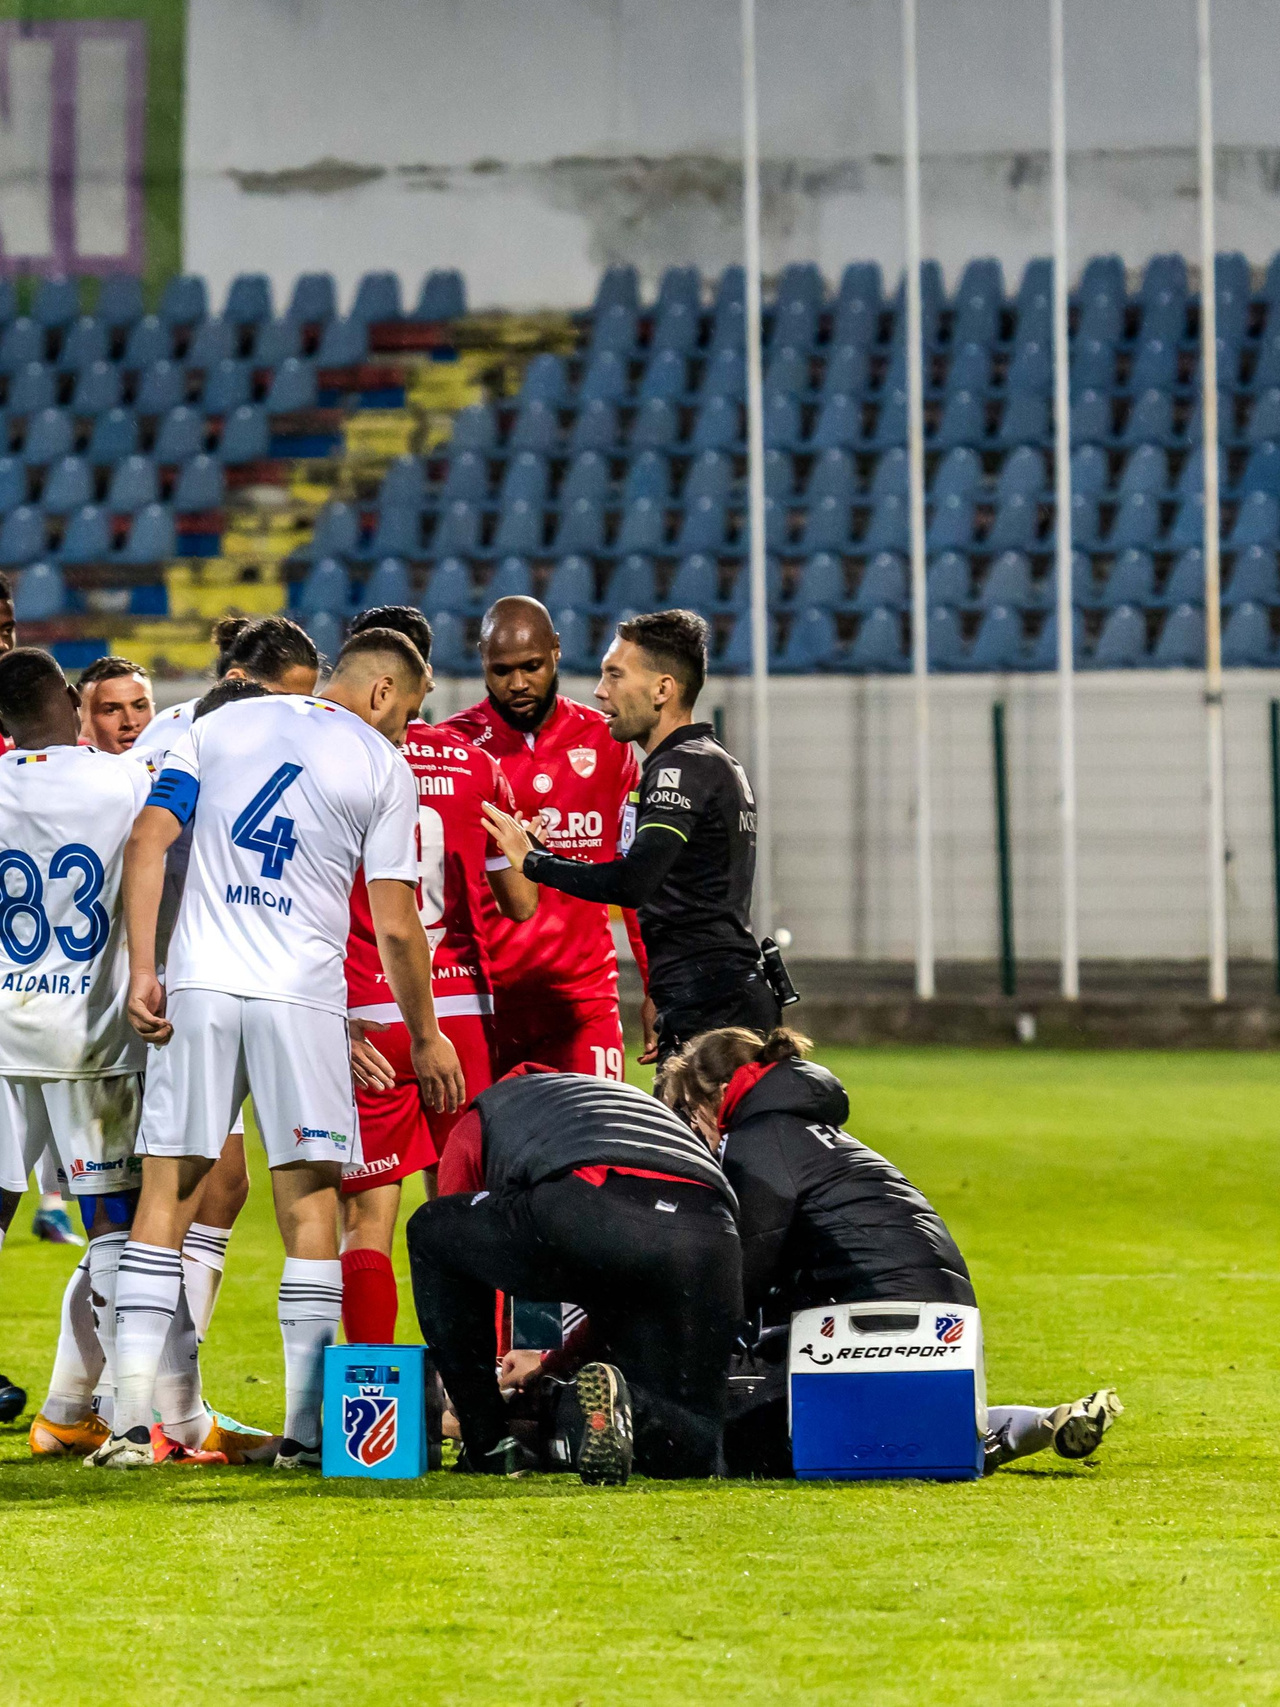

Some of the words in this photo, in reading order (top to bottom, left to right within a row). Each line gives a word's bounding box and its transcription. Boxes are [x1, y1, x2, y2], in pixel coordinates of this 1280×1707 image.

[231, 762, 304, 881] 4
[578, 838, 603, 848] SPORT
[226, 884, 293, 916] MIRON
[590, 1045, 623, 1082] 19
[85, 1158, 124, 1171] Smart
[836, 1346, 962, 1360] RECOSPORT
